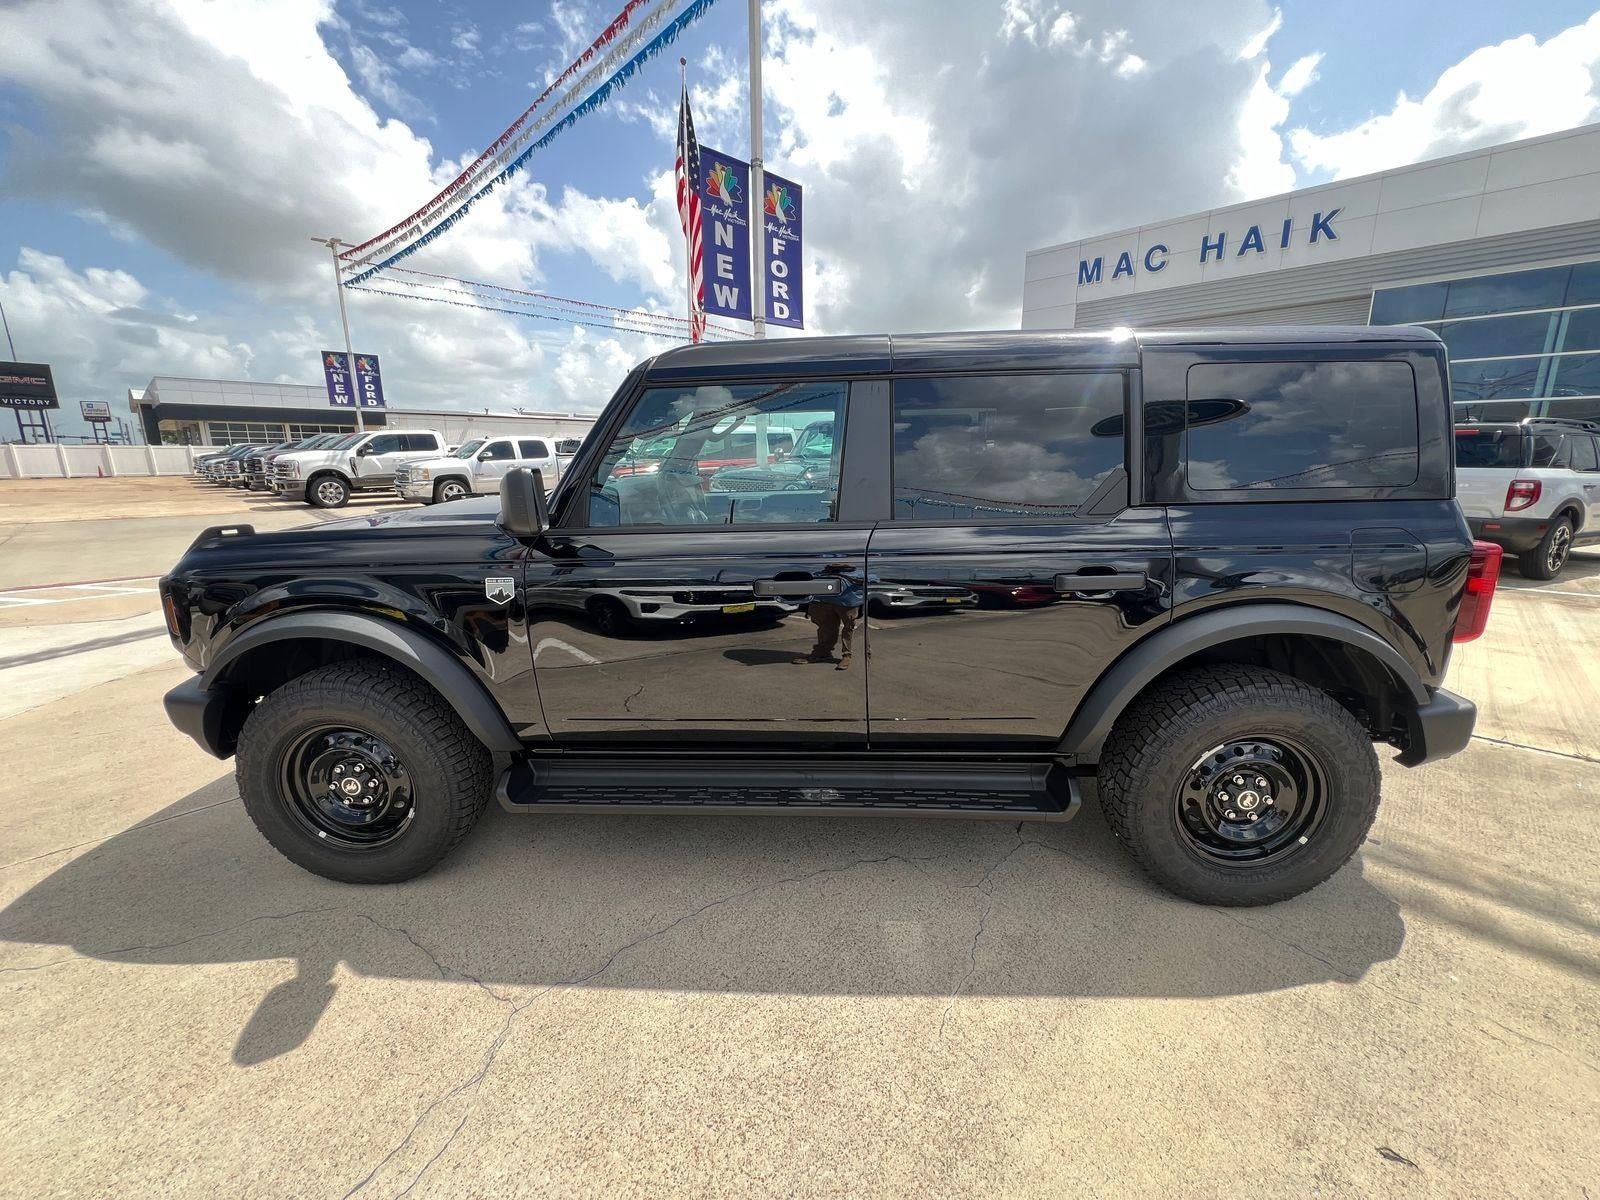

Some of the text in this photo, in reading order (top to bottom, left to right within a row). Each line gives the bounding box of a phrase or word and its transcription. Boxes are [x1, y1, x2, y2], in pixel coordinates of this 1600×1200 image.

[1077, 206, 1345, 286] MAC HAIK
[713, 221, 738, 309] NEW
[771, 238, 789, 319] FORD
[0, 375, 47, 385] GMC
[333, 374, 348, 403] NEW
[365, 376, 377, 405] FORD
[2, 398, 50, 406] VICTORY
